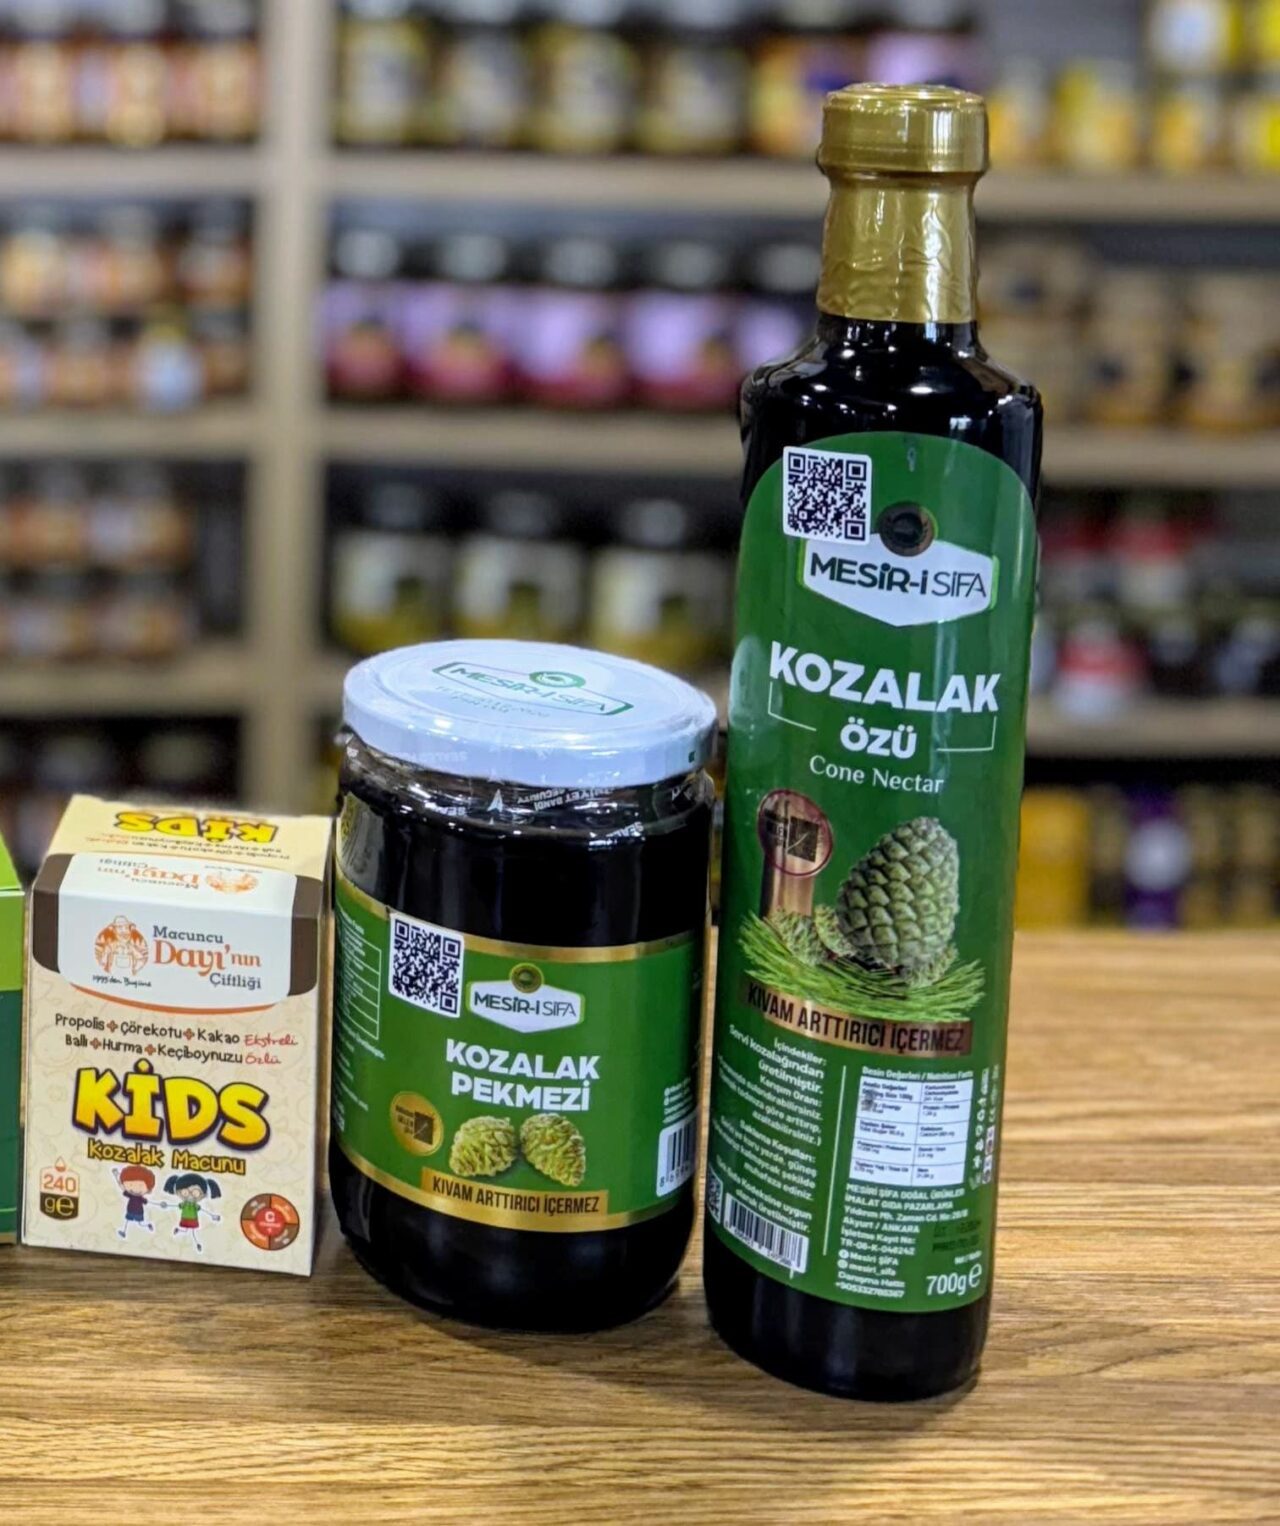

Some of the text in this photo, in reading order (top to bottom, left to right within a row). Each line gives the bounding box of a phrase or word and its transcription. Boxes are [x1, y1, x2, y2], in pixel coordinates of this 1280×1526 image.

[769, 640, 1001, 713] KOZALAK
[840, 716, 917, 759] ÖZÜ
[809, 755, 945, 794] Cone Nectar
[153, 925, 223, 944] Macuncu
[209, 972, 261, 990] Çiftliği
[55, 1014, 105, 1033] Propolis
[120, 1021, 183, 1040] Çörekotu
[197, 1028, 240, 1045] Kakao
[747, 983, 964, 1053] KIVAM ARTTIRICI İÇERMEZ
[103, 1040, 143, 1055] Hurma
[158, 1043, 243, 1065] Keçiboynuzu
[446, 1038, 600, 1081] KOZALAK
[72, 1058, 270, 1151] KİDS
[451, 1071, 590, 1111] PEKMEZİ
[88, 1138, 247, 1176] Kozalak Macunu
[43, 1174, 76, 1193] 240
[432, 1175, 600, 1216] KIVAM ARTTIRICI İÇERMEZ
